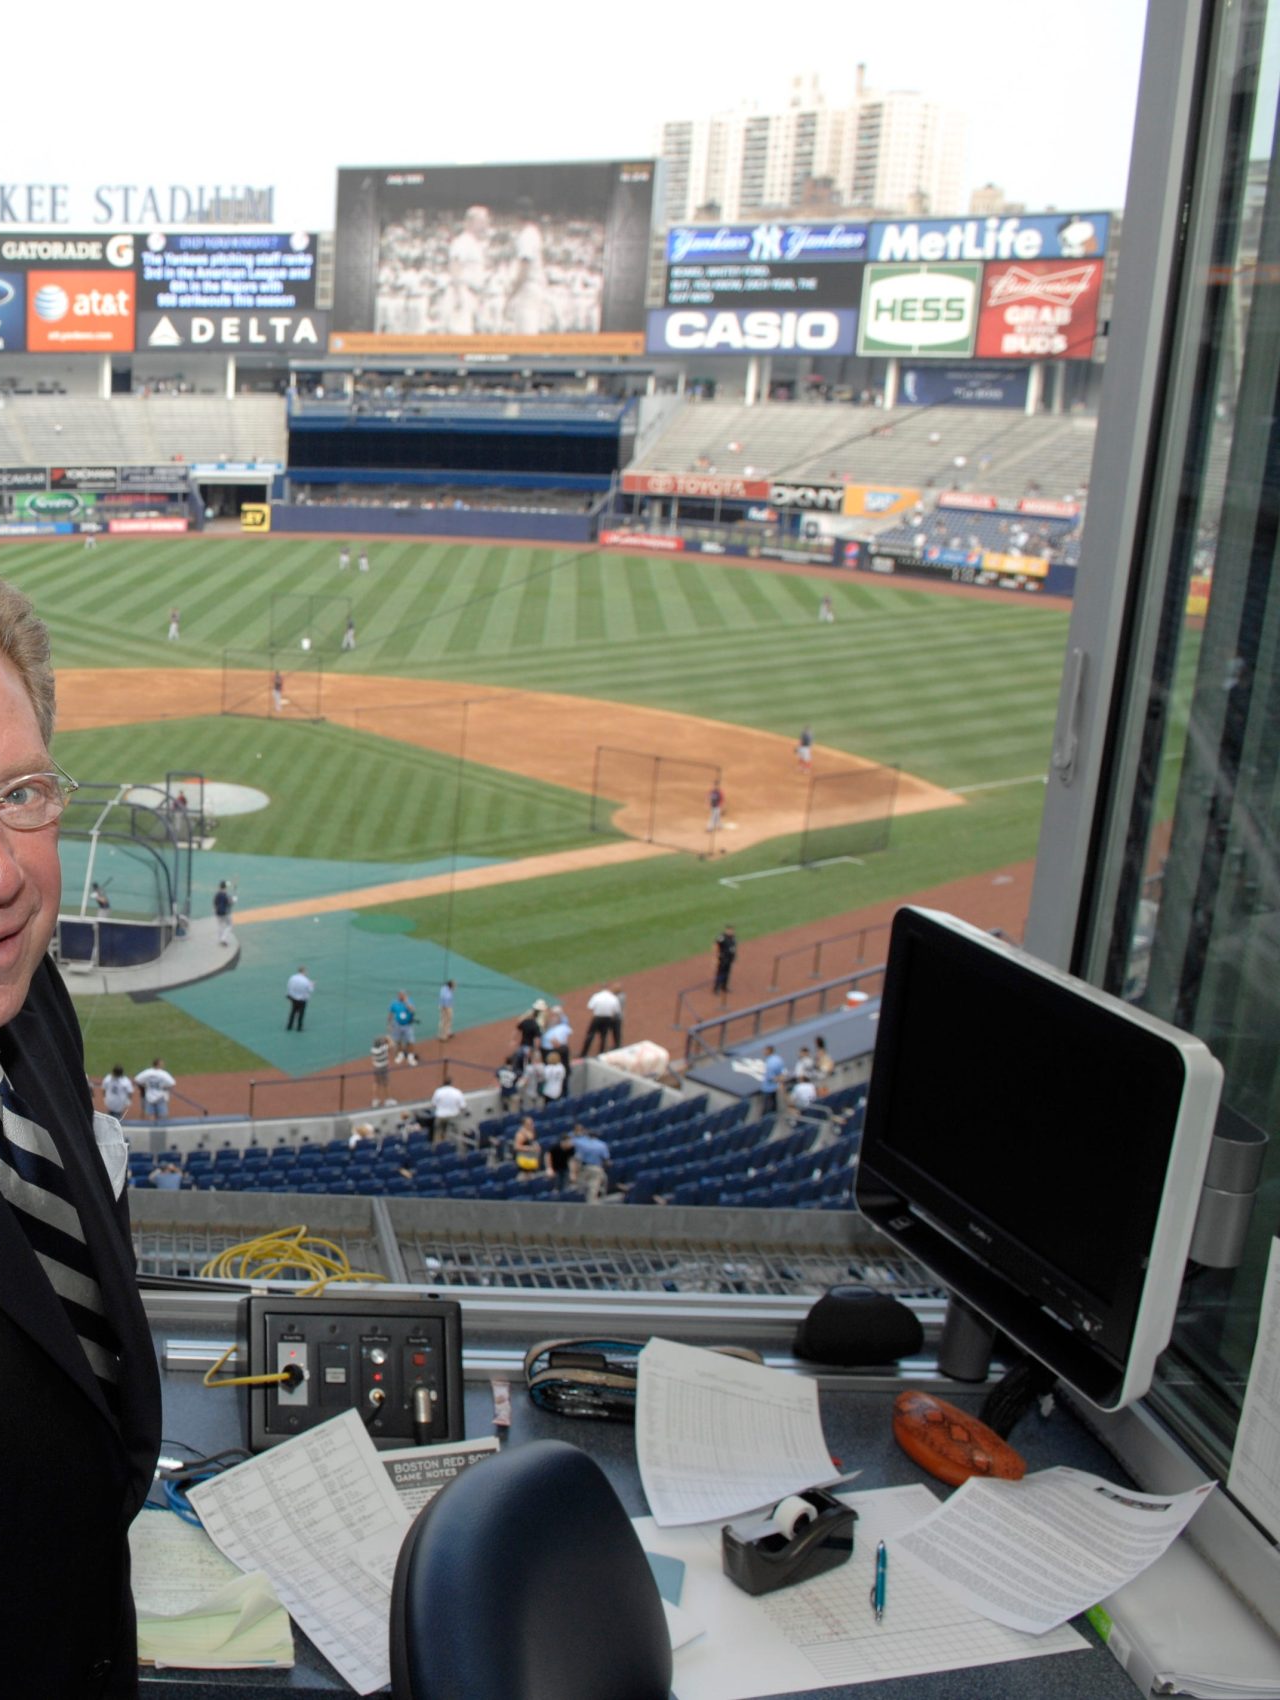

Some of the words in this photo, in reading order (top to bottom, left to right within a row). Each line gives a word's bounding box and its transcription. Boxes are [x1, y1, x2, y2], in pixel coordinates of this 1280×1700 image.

[92, 184, 276, 226] STADIUM
[2, 240, 103, 260] GATORADE
[106, 234, 135, 267] G
[670, 227, 751, 262] Yankees
[784, 223, 866, 260] Yankees
[876, 216, 1043, 262] MetLife
[72, 289, 130, 317] at&t
[874, 297, 966, 322] HESS
[1003, 305, 1072, 326] GRAB
[191, 316, 318, 343] DELTA
[665, 311, 839, 350] CASIO
[1001, 333, 1068, 354] BUDS
[676, 477, 747, 497] TOYOTA
[770, 483, 843, 511] DKNY
[393, 1460, 440, 1474] BOSTON
[443, 1456, 465, 1467] RED
[395, 1471, 422, 1483] GAME
[426, 1467, 458, 1479] NOTES
